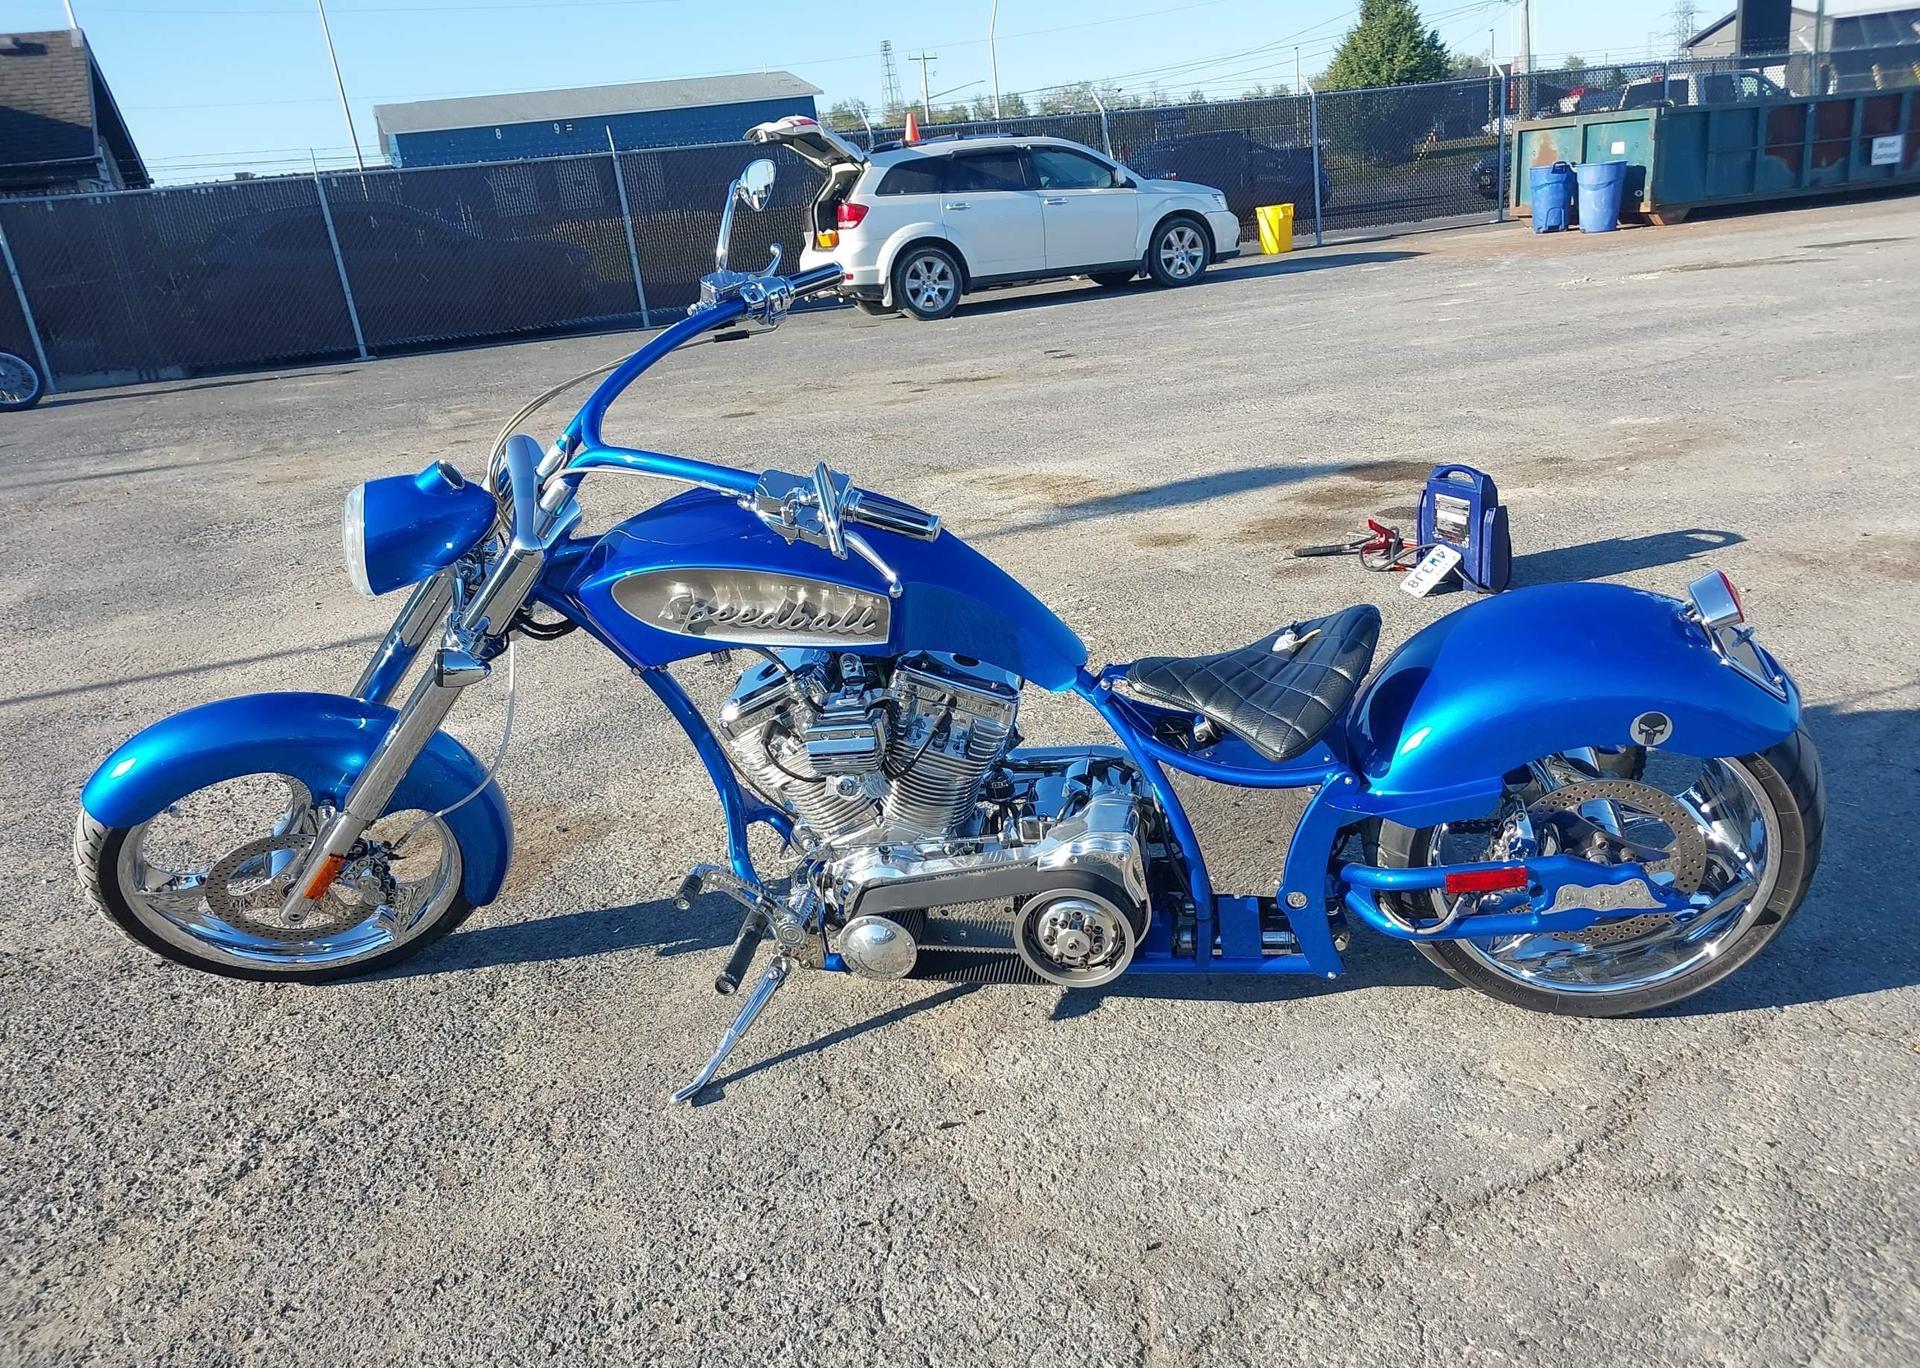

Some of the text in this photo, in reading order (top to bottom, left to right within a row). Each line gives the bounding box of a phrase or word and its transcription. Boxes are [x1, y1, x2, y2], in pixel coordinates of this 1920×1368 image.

[495, 128, 502, 140] 8
[553, 122, 560, 135] 9
[658, 593, 877, 635] Speedball
